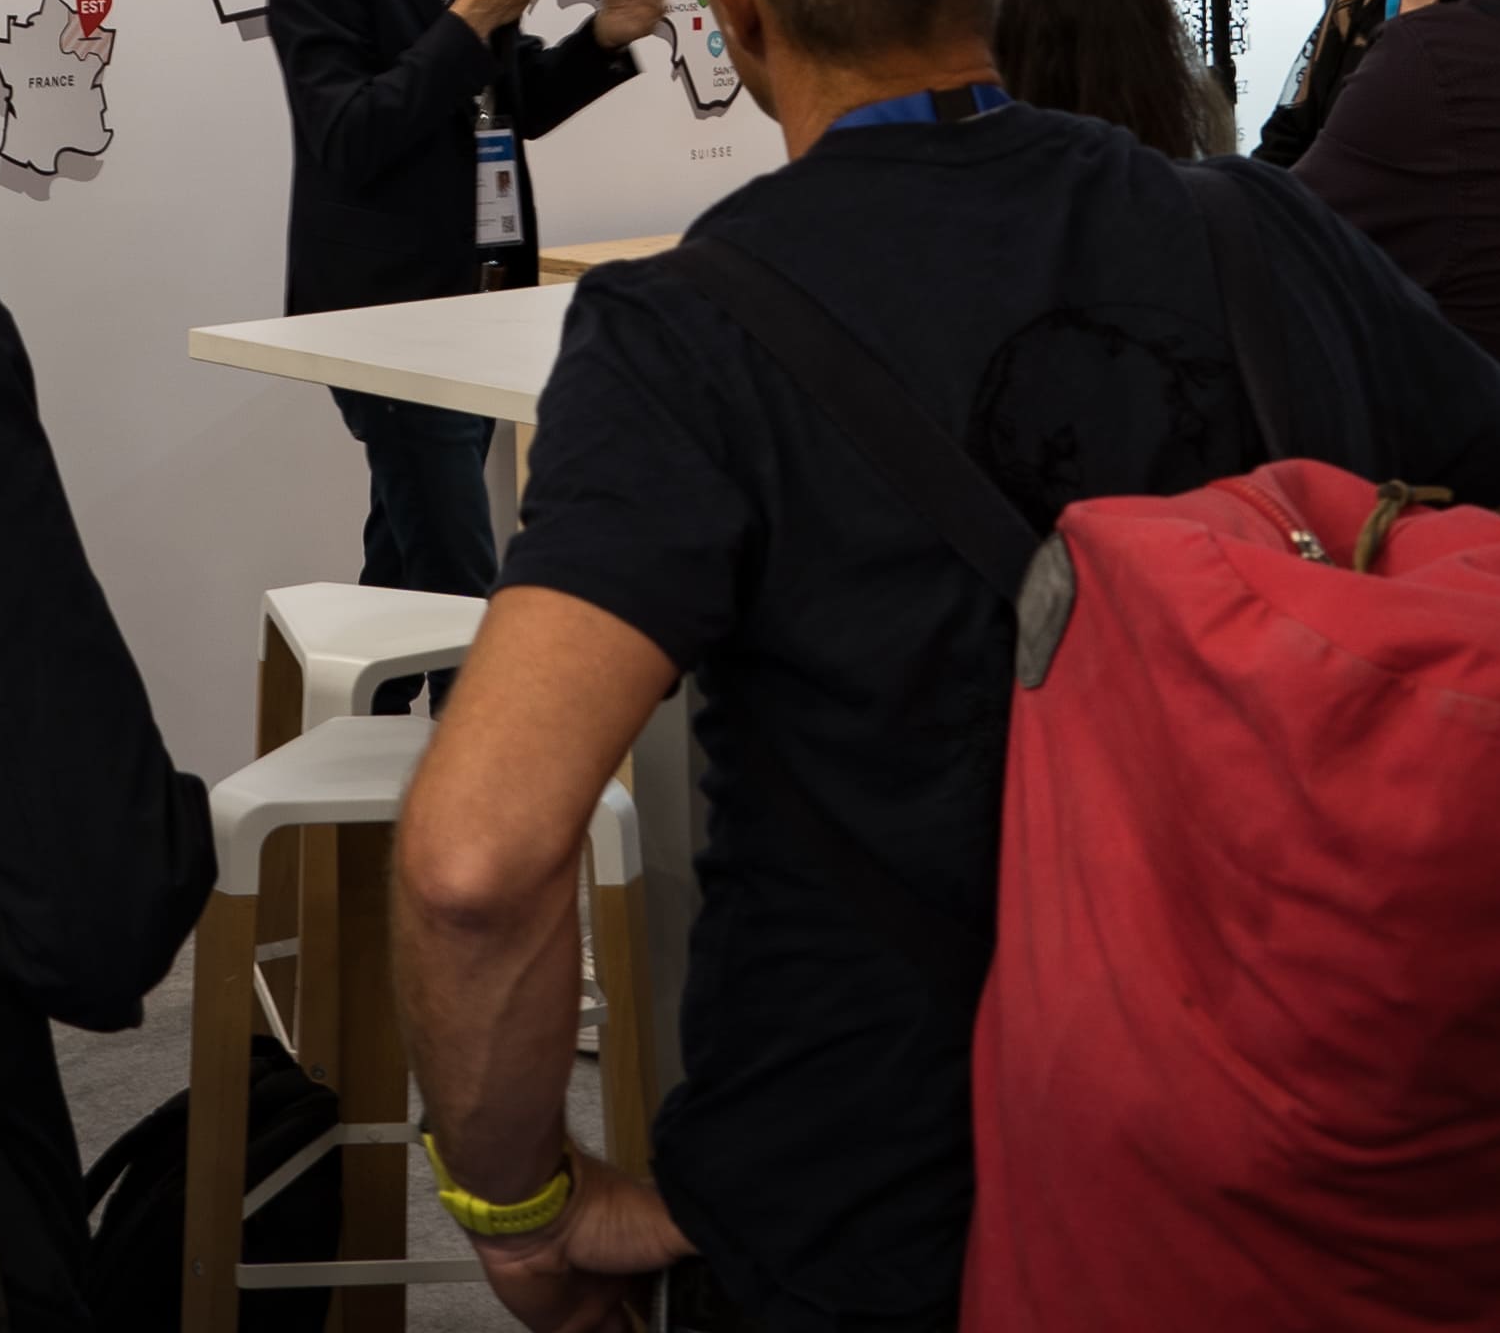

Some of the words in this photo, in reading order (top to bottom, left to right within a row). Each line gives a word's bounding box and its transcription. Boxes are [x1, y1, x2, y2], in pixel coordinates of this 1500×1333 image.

[81, 0, 106, 14] EST
[664, 4, 698, 13] LHOUSE
[28, 75, 74, 88] FRANCE
[713, 78, 735, 87] LOUIS
[691, 146, 732, 160] SUISSE
